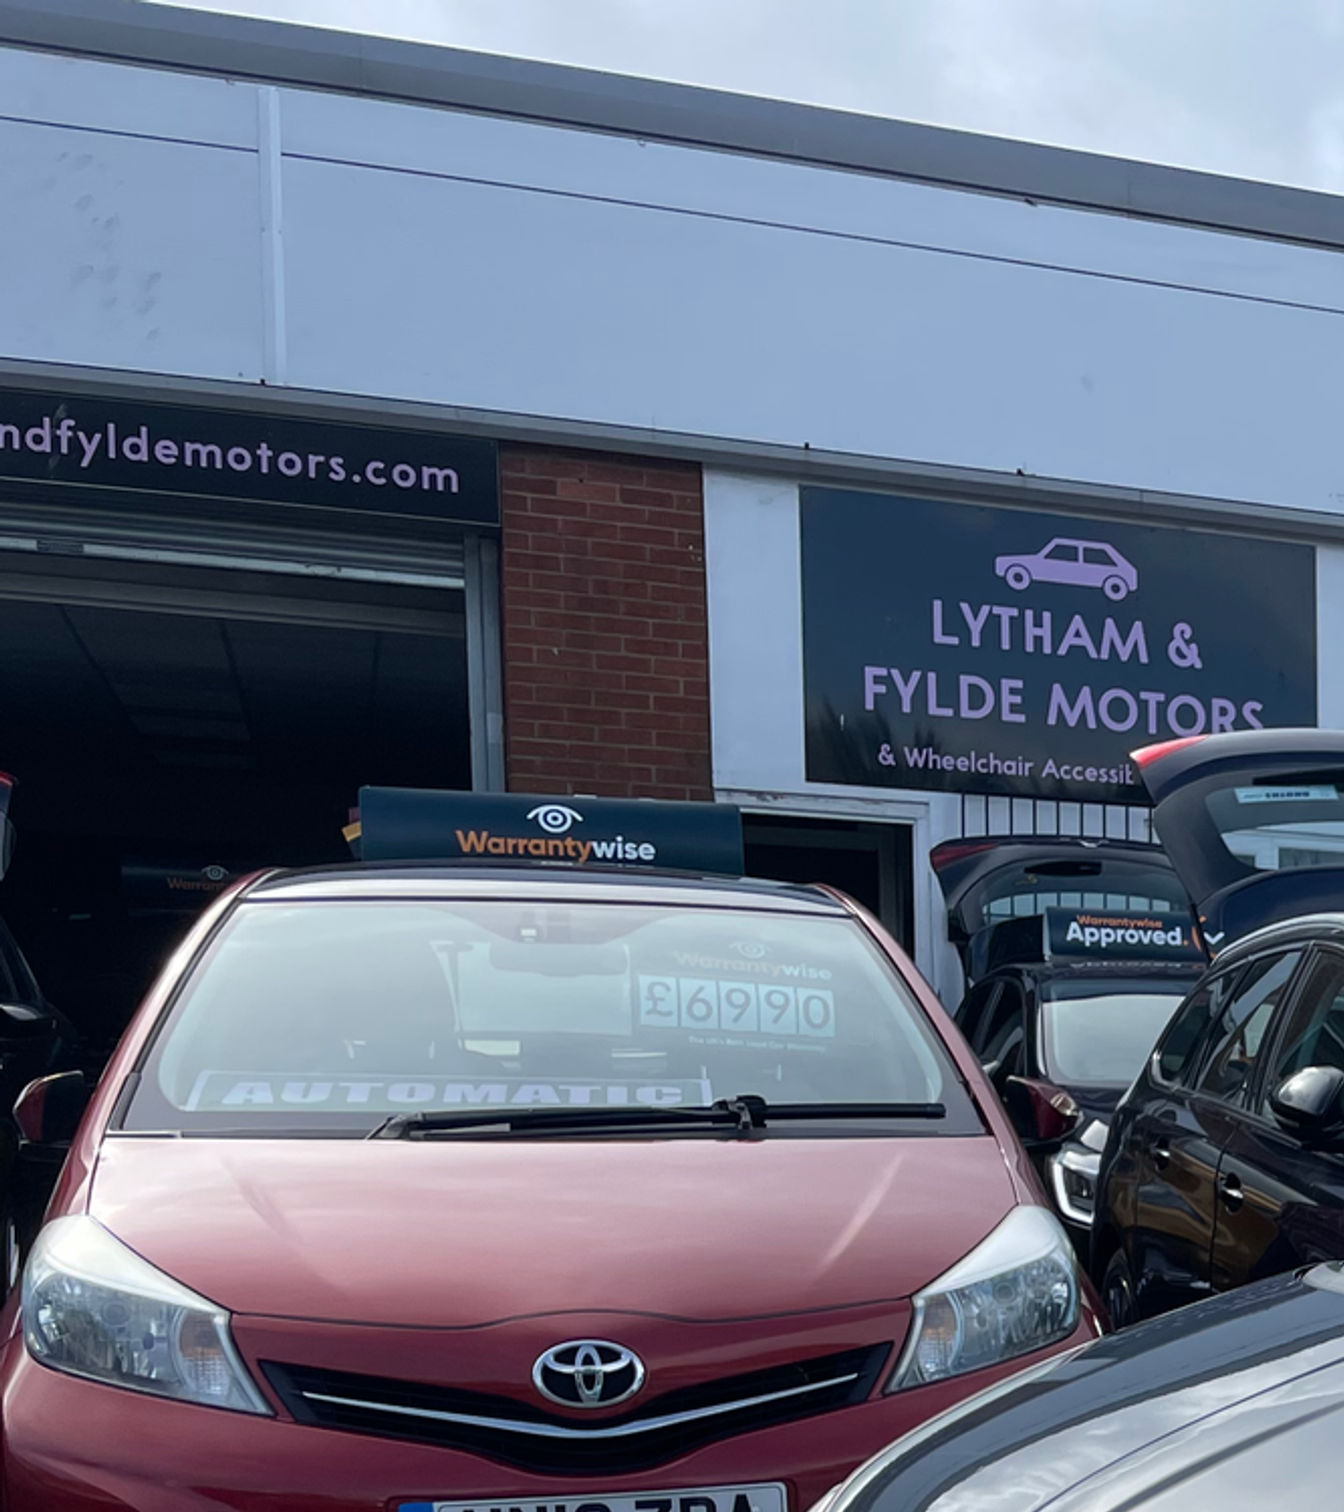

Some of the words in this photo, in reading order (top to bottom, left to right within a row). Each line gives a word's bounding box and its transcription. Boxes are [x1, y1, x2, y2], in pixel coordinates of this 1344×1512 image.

[0, 417, 459, 492] ndfyldemotors.com
[932, 599, 1149, 664] LYTHAM
[1167, 622, 1202, 669] &
[864, 665, 1026, 723] FYLDE
[1047, 683, 1263, 735] MOTORS
[877, 744, 896, 767] &
[904, 746, 1034, 778] Wheelchair
[455, 829, 656, 862] Warrantywise
[1076, 914, 1163, 929] Warrantywise
[675, 951, 833, 981] Warrantywise
[643, 981, 831, 1030] £6990
[221, 1081, 683, 1106] AUTOMATIC
